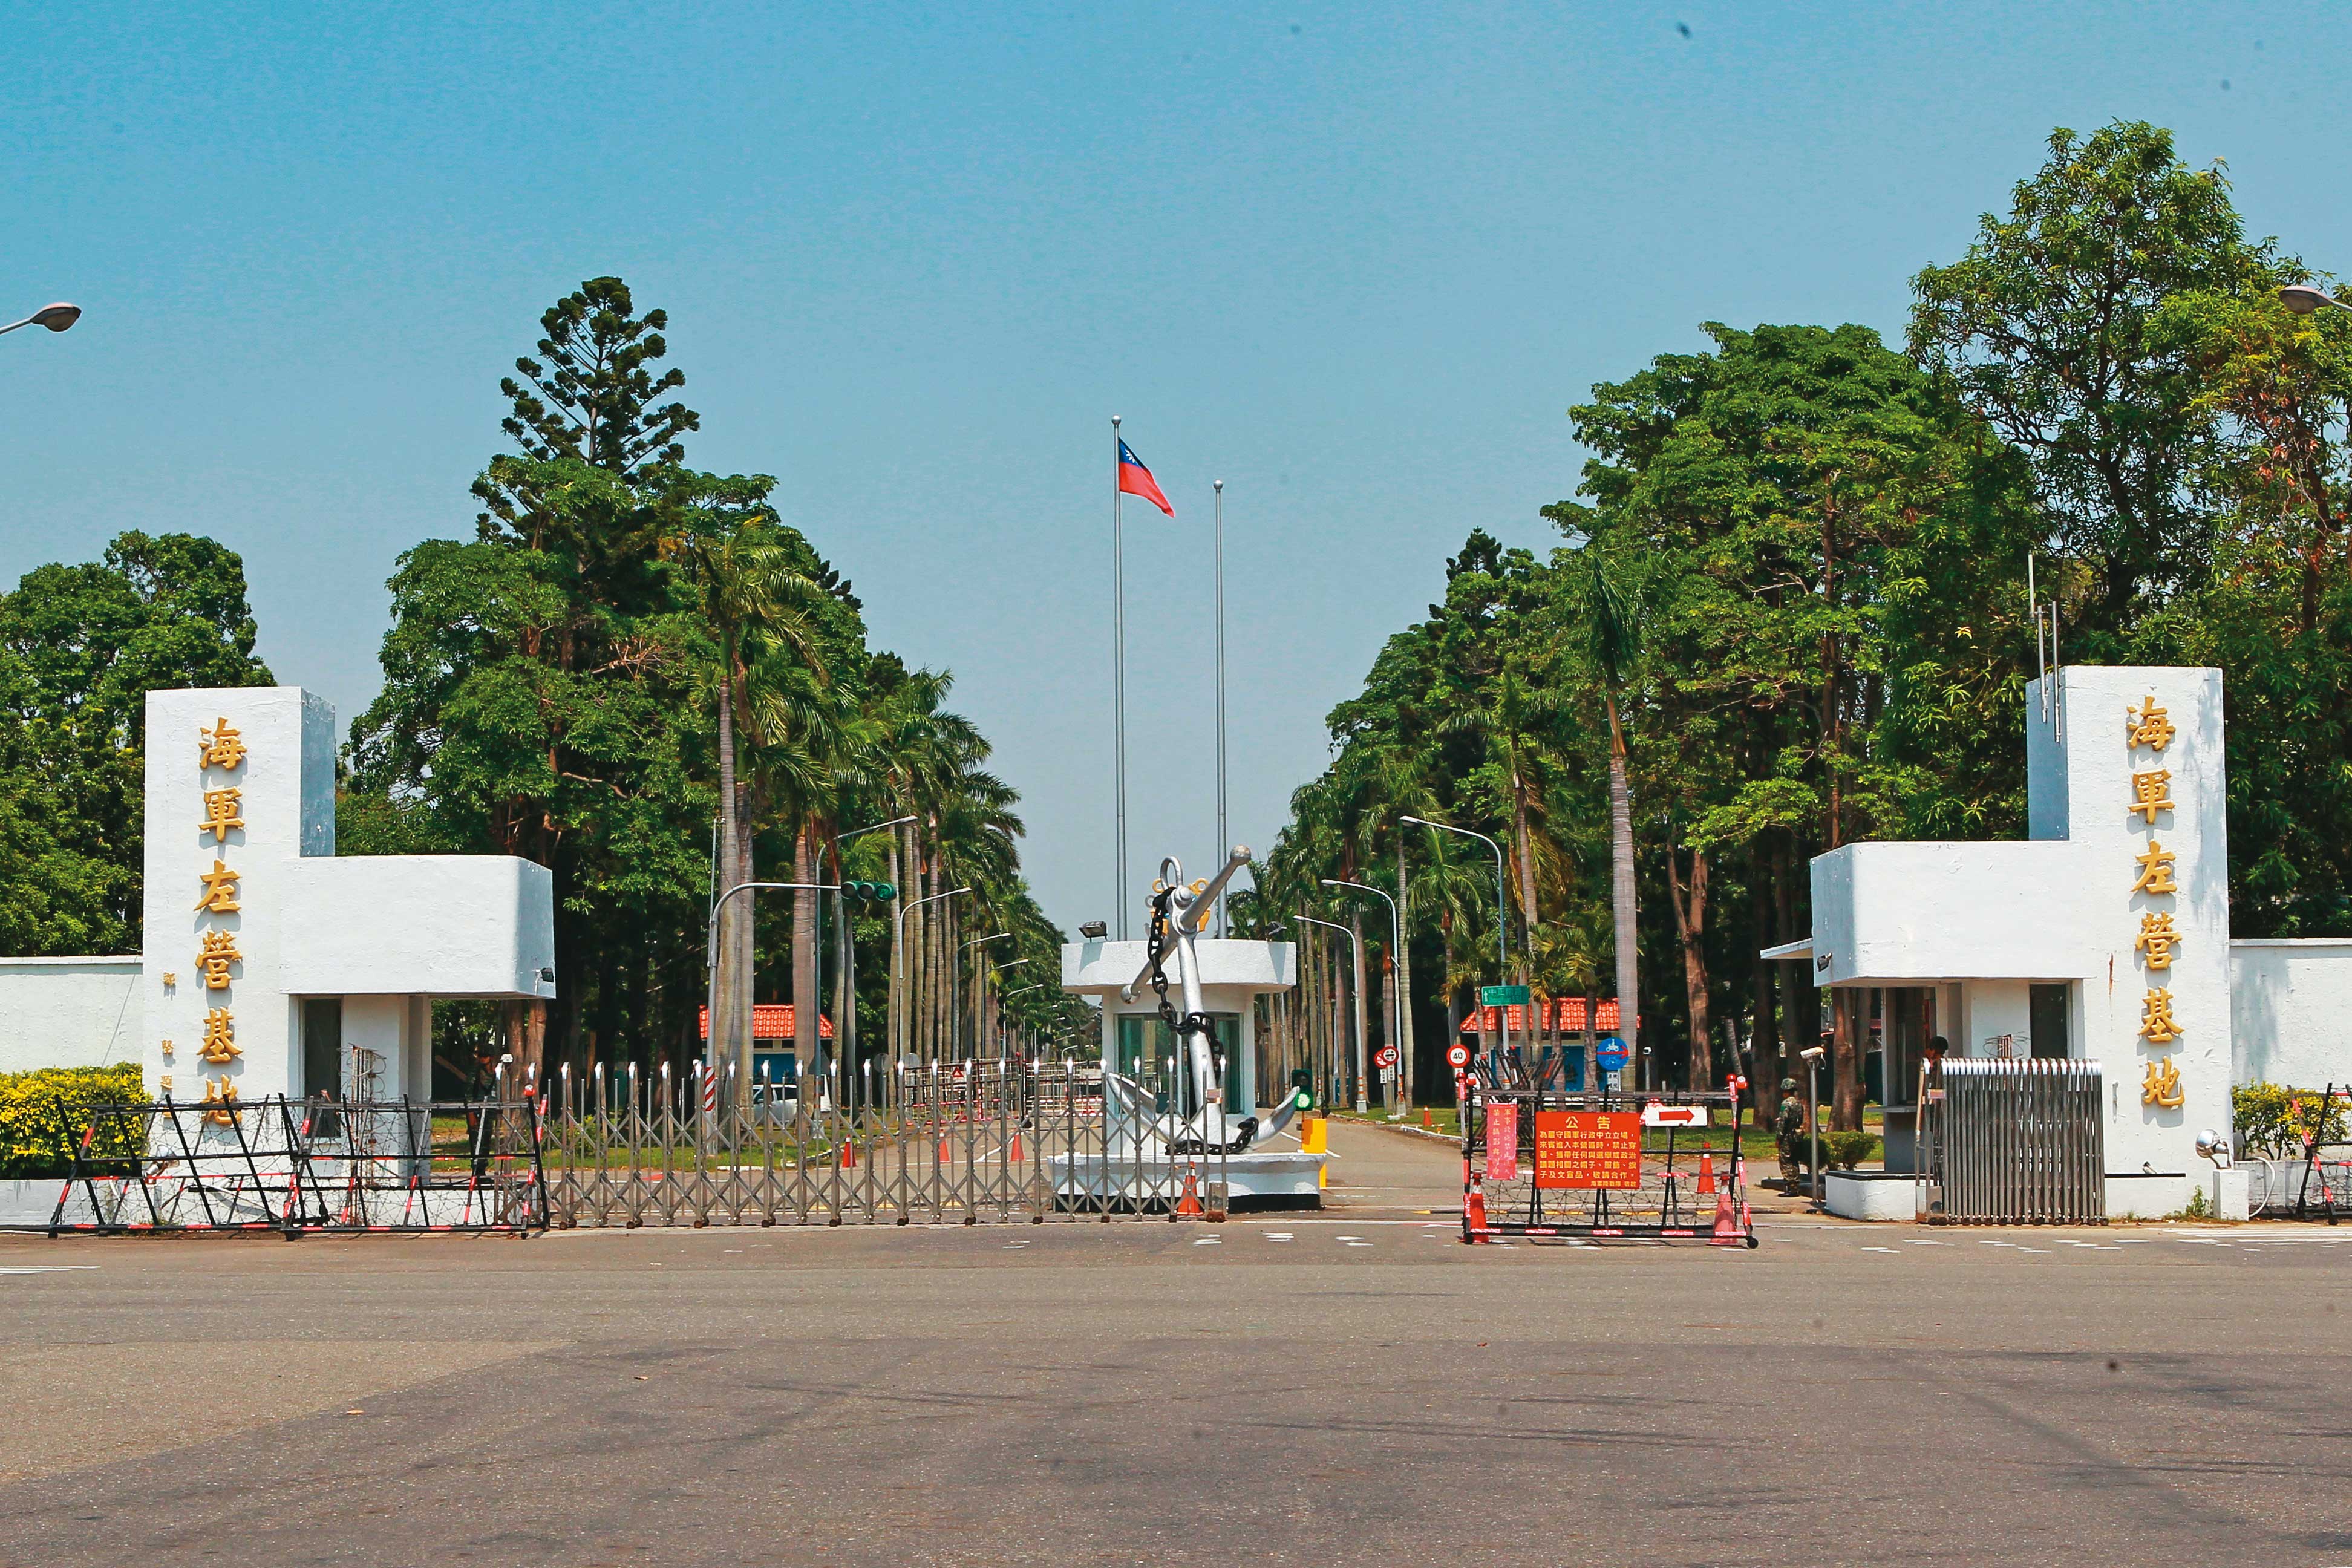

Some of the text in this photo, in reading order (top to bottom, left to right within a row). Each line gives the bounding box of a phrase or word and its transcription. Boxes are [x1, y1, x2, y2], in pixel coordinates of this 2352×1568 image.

[194, 716, 247, 1126] 海軍左營基地
[2126, 696, 2186, 1108] 海軍左營基地
